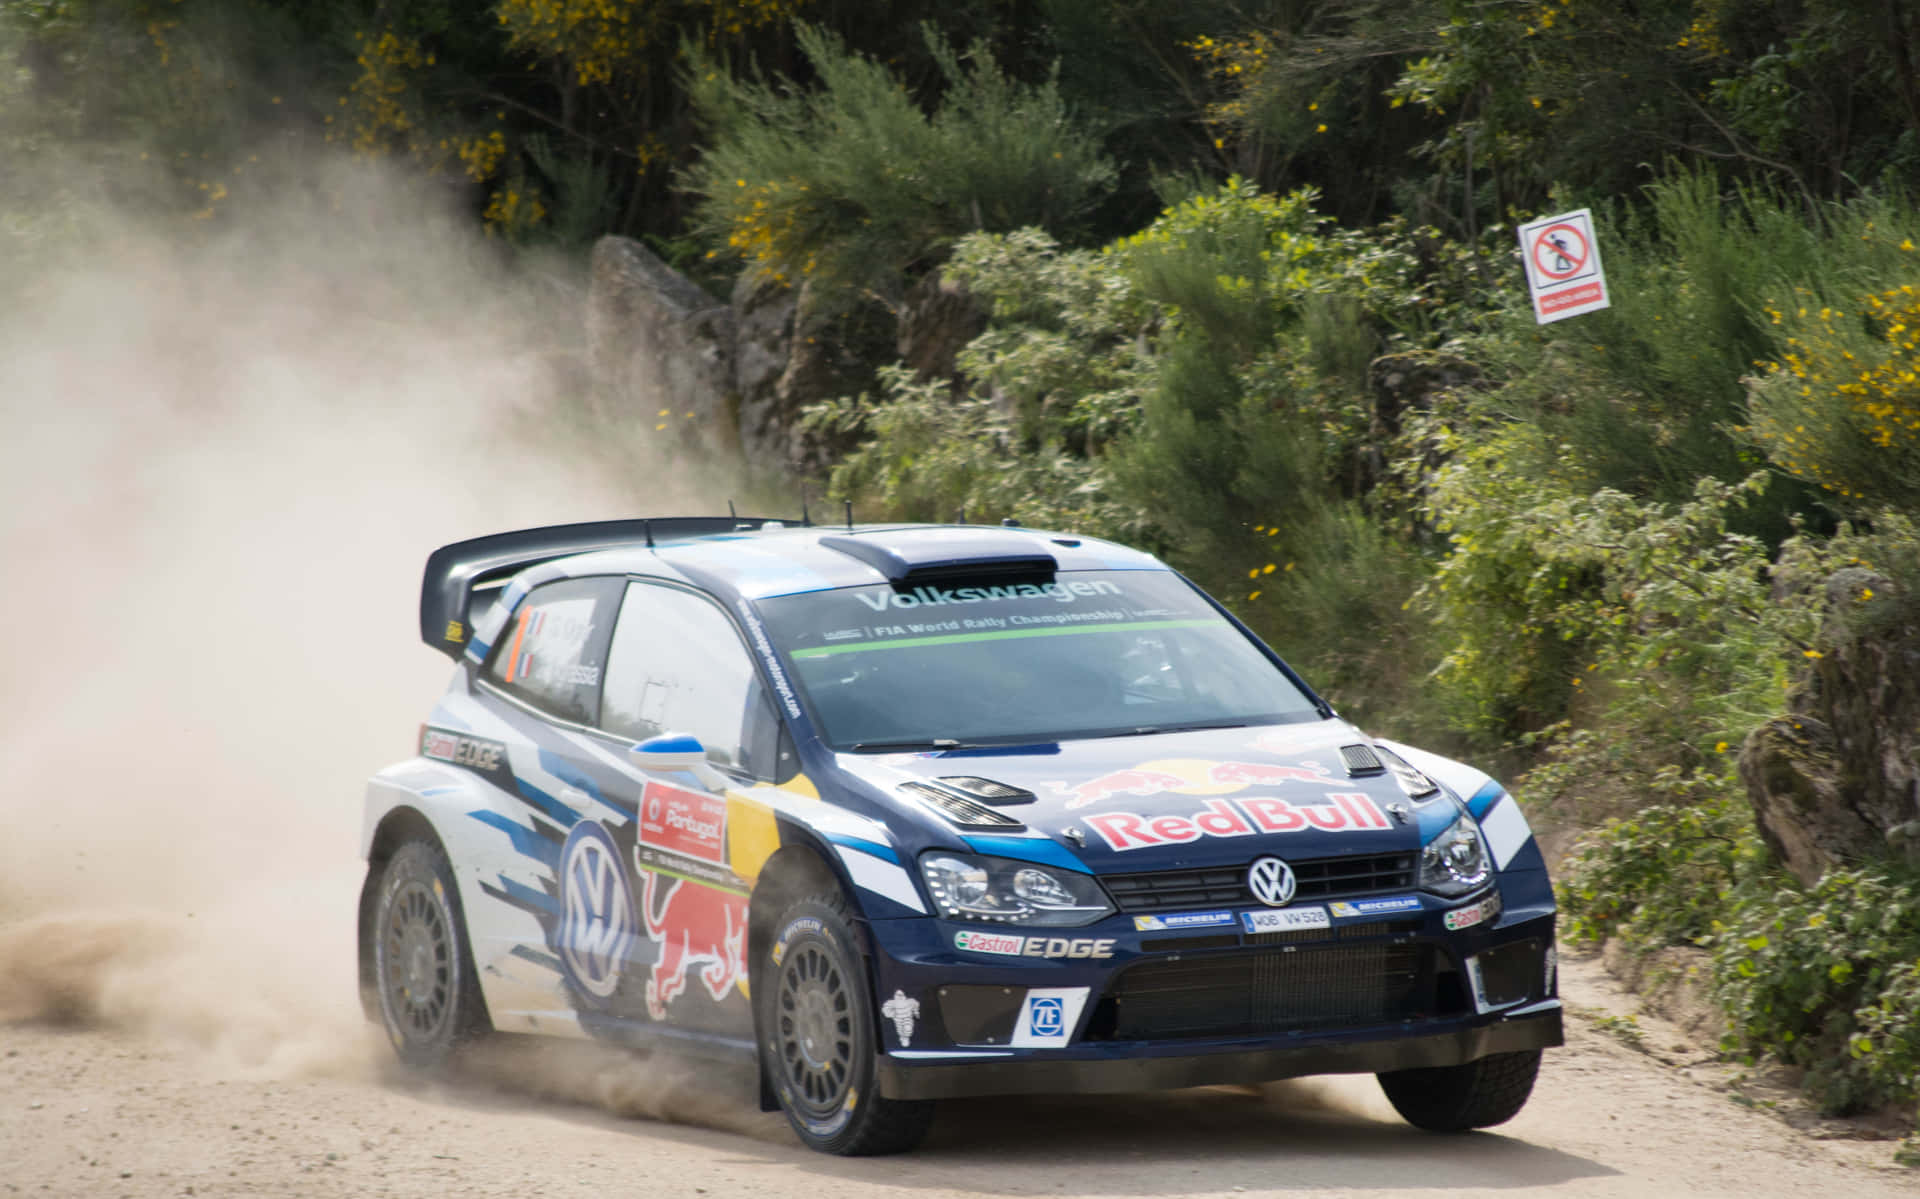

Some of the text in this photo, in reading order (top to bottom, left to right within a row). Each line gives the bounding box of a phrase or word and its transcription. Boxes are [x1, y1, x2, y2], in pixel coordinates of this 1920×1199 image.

[854, 579, 1123, 613] Volkswagen
[875, 625, 905, 638] FIA
[907, 619, 960, 634] World
[964, 615, 1007, 631] Rally
[1009, 609, 1125, 627] Championship
[455, 738, 505, 771] EDGE
[666, 809, 721, 840] Portugal
[1080, 792, 1394, 852] Red Bull
[1301, 911, 1327, 923] 528
[1358, 898, 1418, 911] MICHELIN
[1165, 913, 1231, 925] MICHELIN
[968, 933, 1118, 959] Castrol EDGE
[1033, 1006, 1061, 1028] ZF
